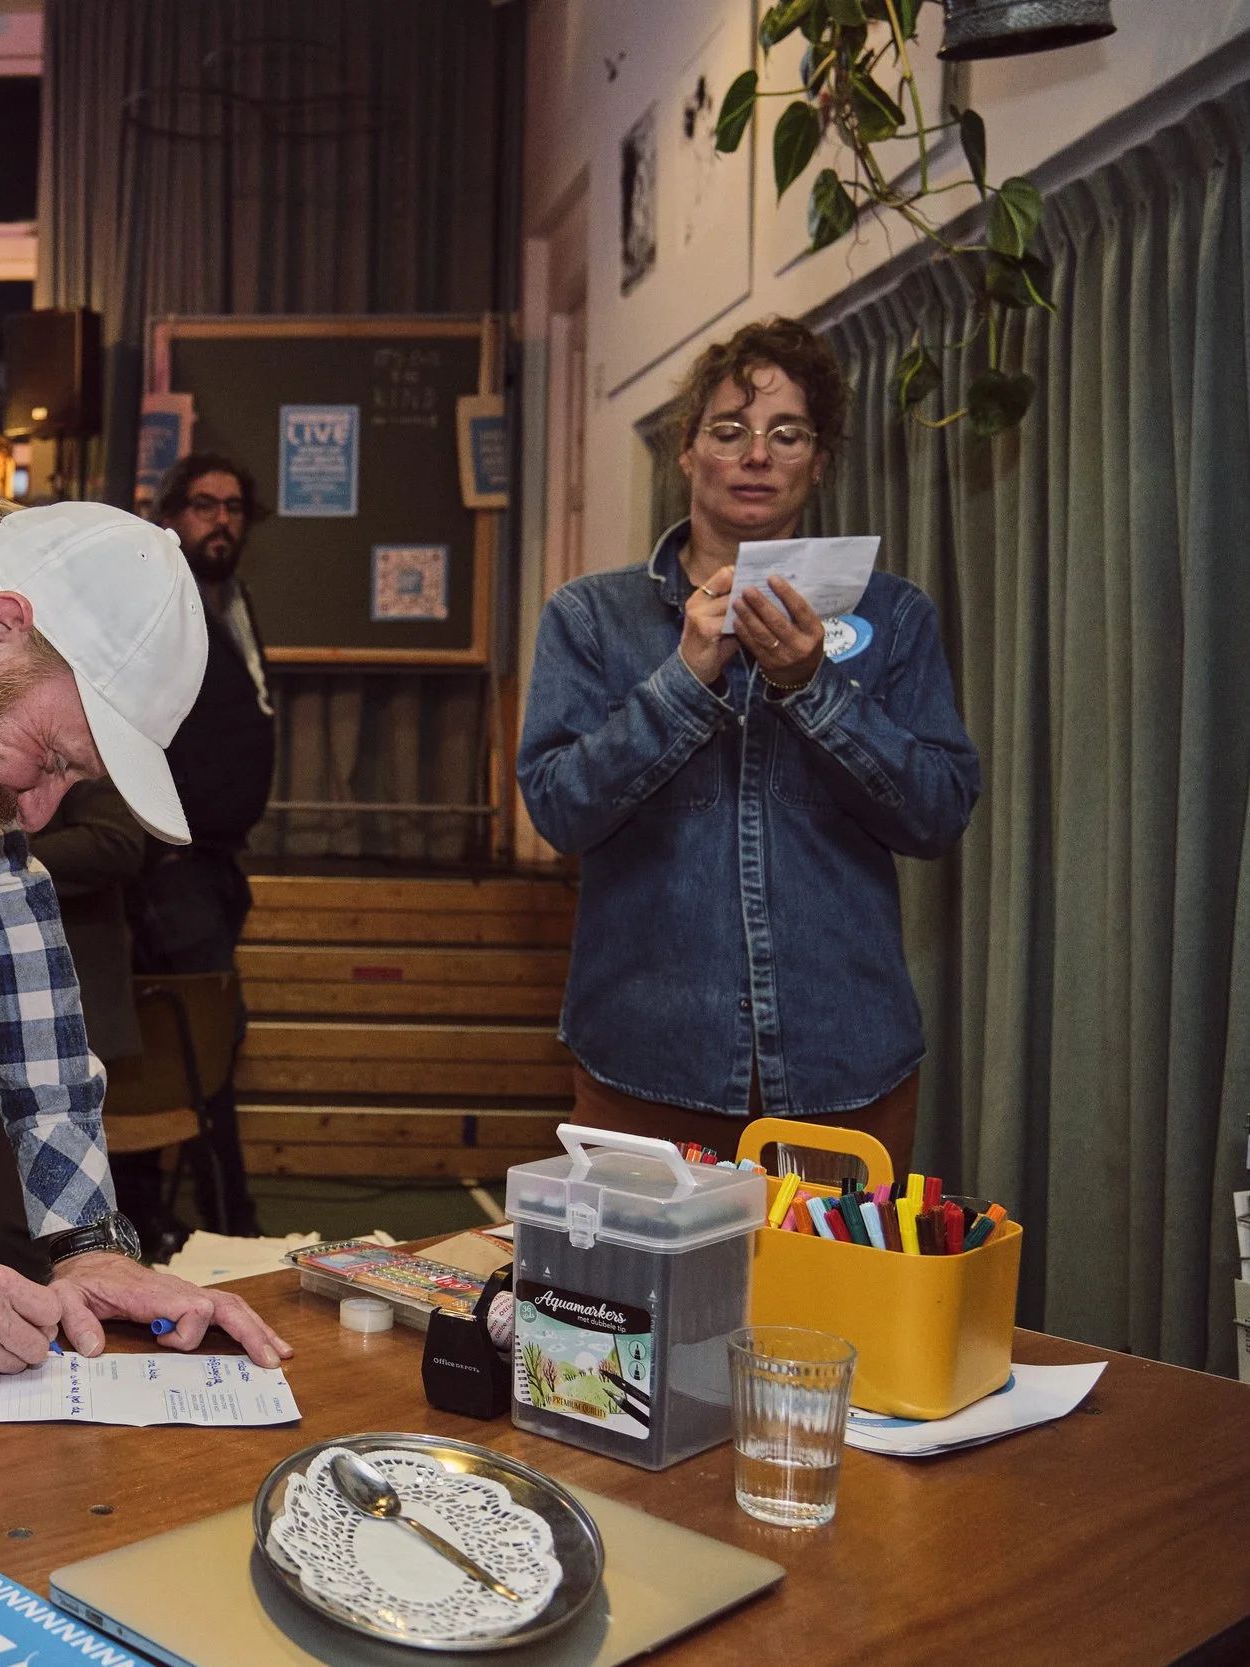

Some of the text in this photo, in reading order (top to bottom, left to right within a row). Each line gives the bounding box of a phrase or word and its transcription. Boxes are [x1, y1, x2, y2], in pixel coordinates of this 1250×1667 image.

[535, 1290, 626, 1324] Aquamarkers
[577, 1315, 626, 1333] met dubbele tip
[433, 1357, 455, 1367] Office
[553, 1395, 606, 1419] PREMIUM QUALITY
